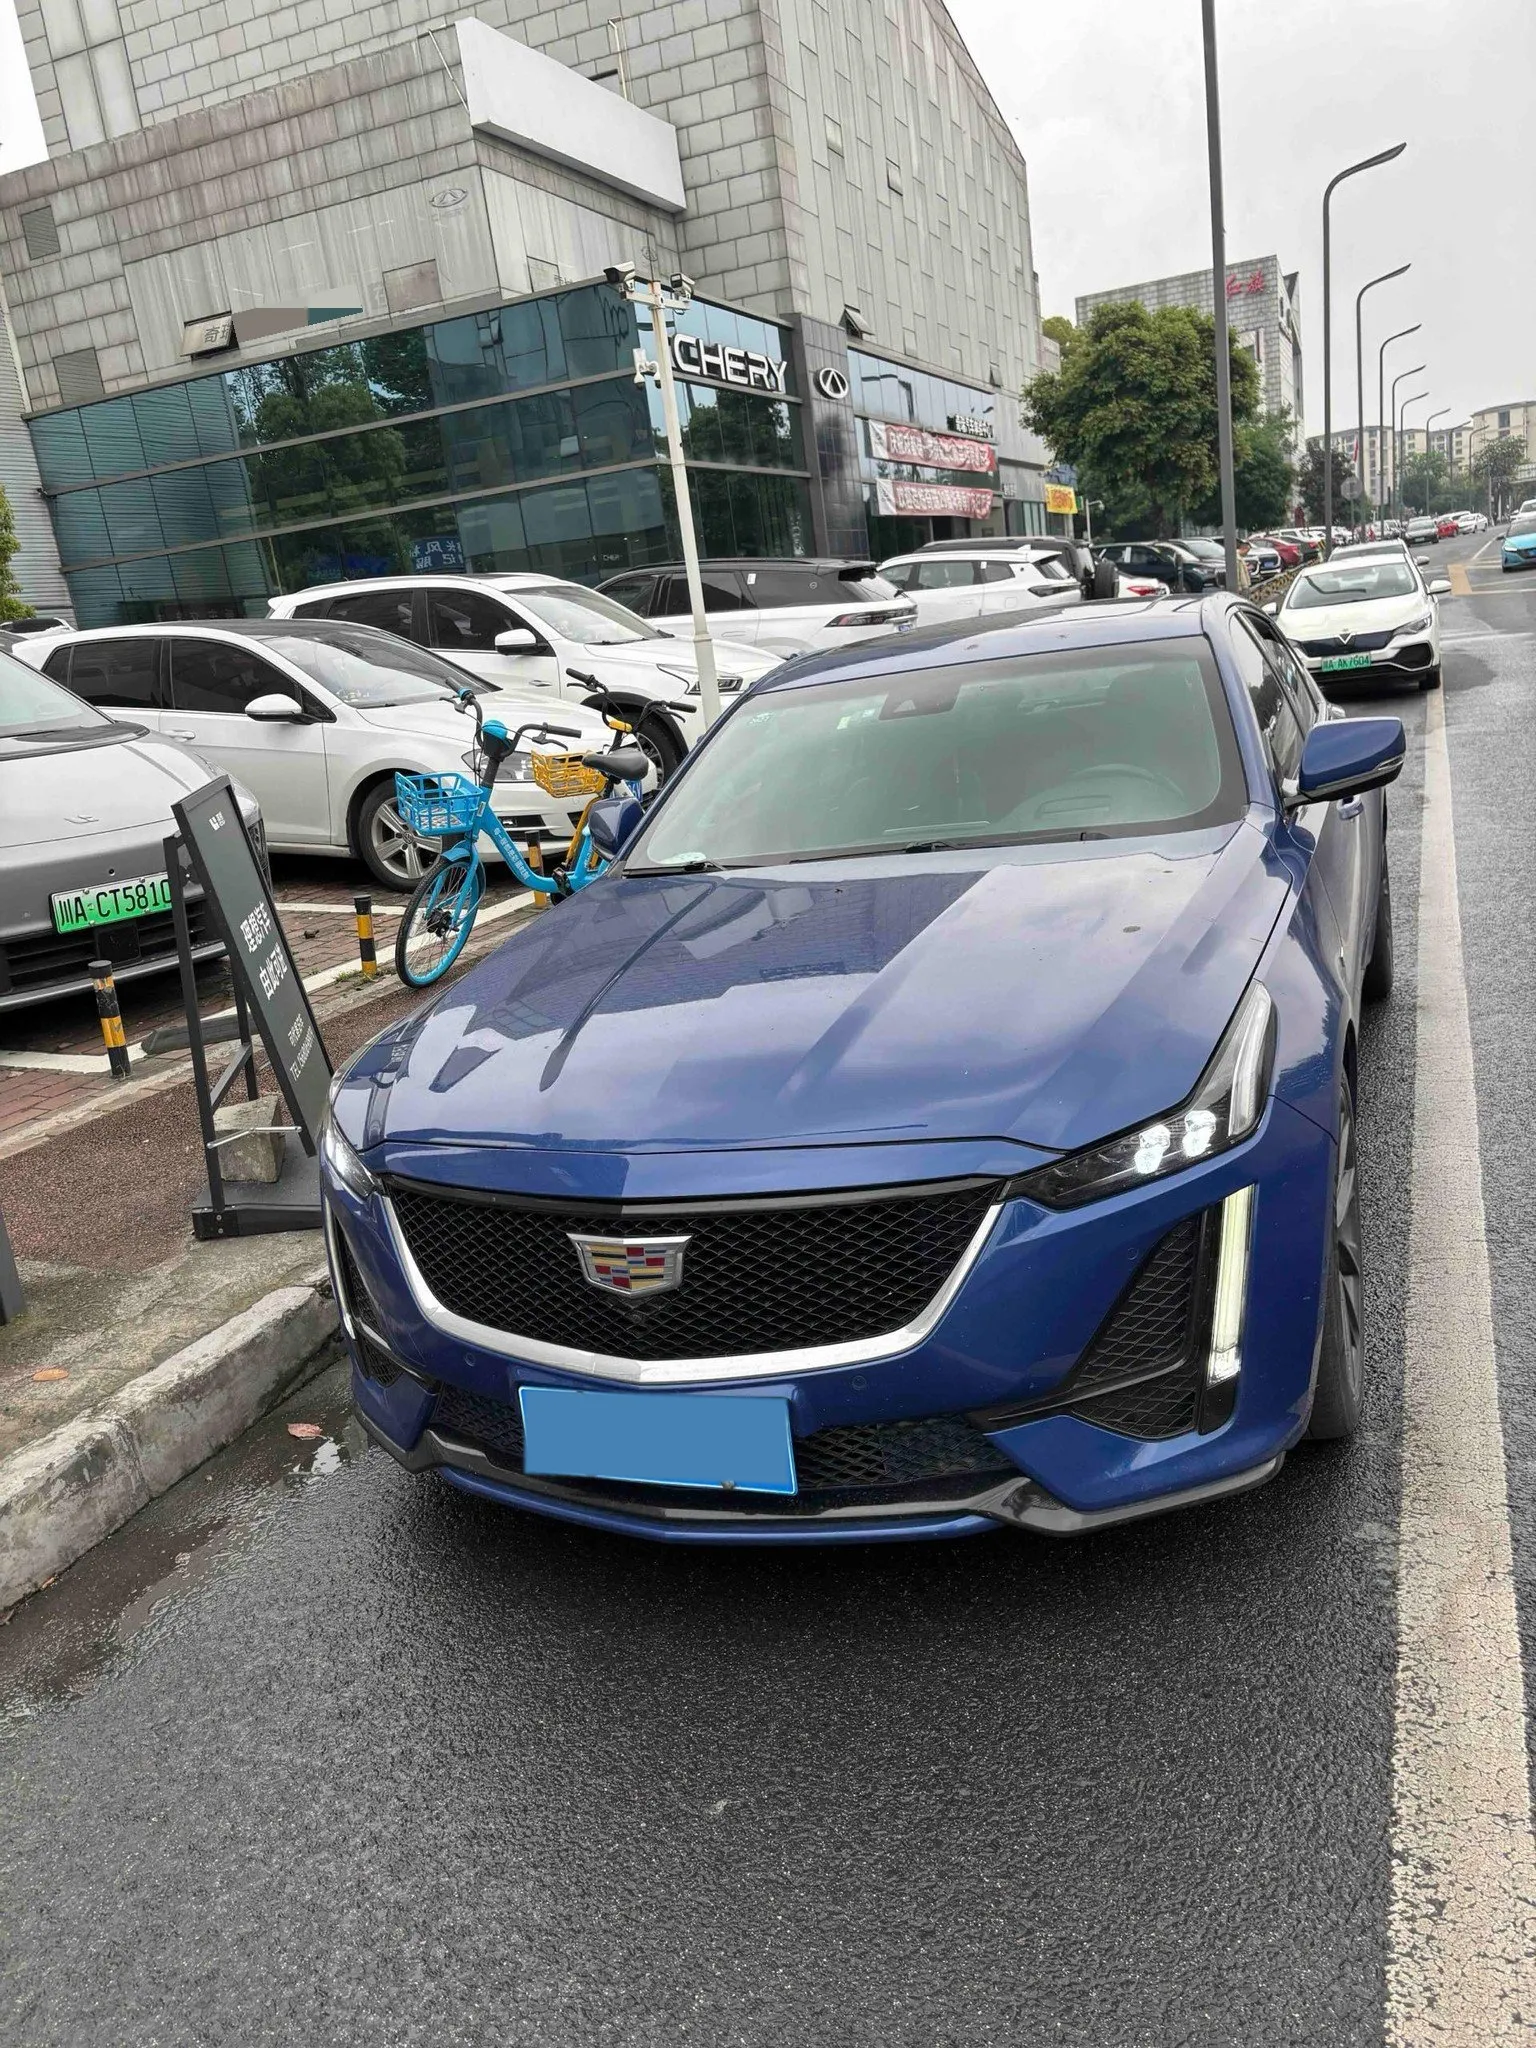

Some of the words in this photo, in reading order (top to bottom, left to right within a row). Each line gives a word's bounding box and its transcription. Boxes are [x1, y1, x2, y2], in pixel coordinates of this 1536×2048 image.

[674, 333, 788, 393] CHERY
[240, 901, 271, 953] 理想汽车
